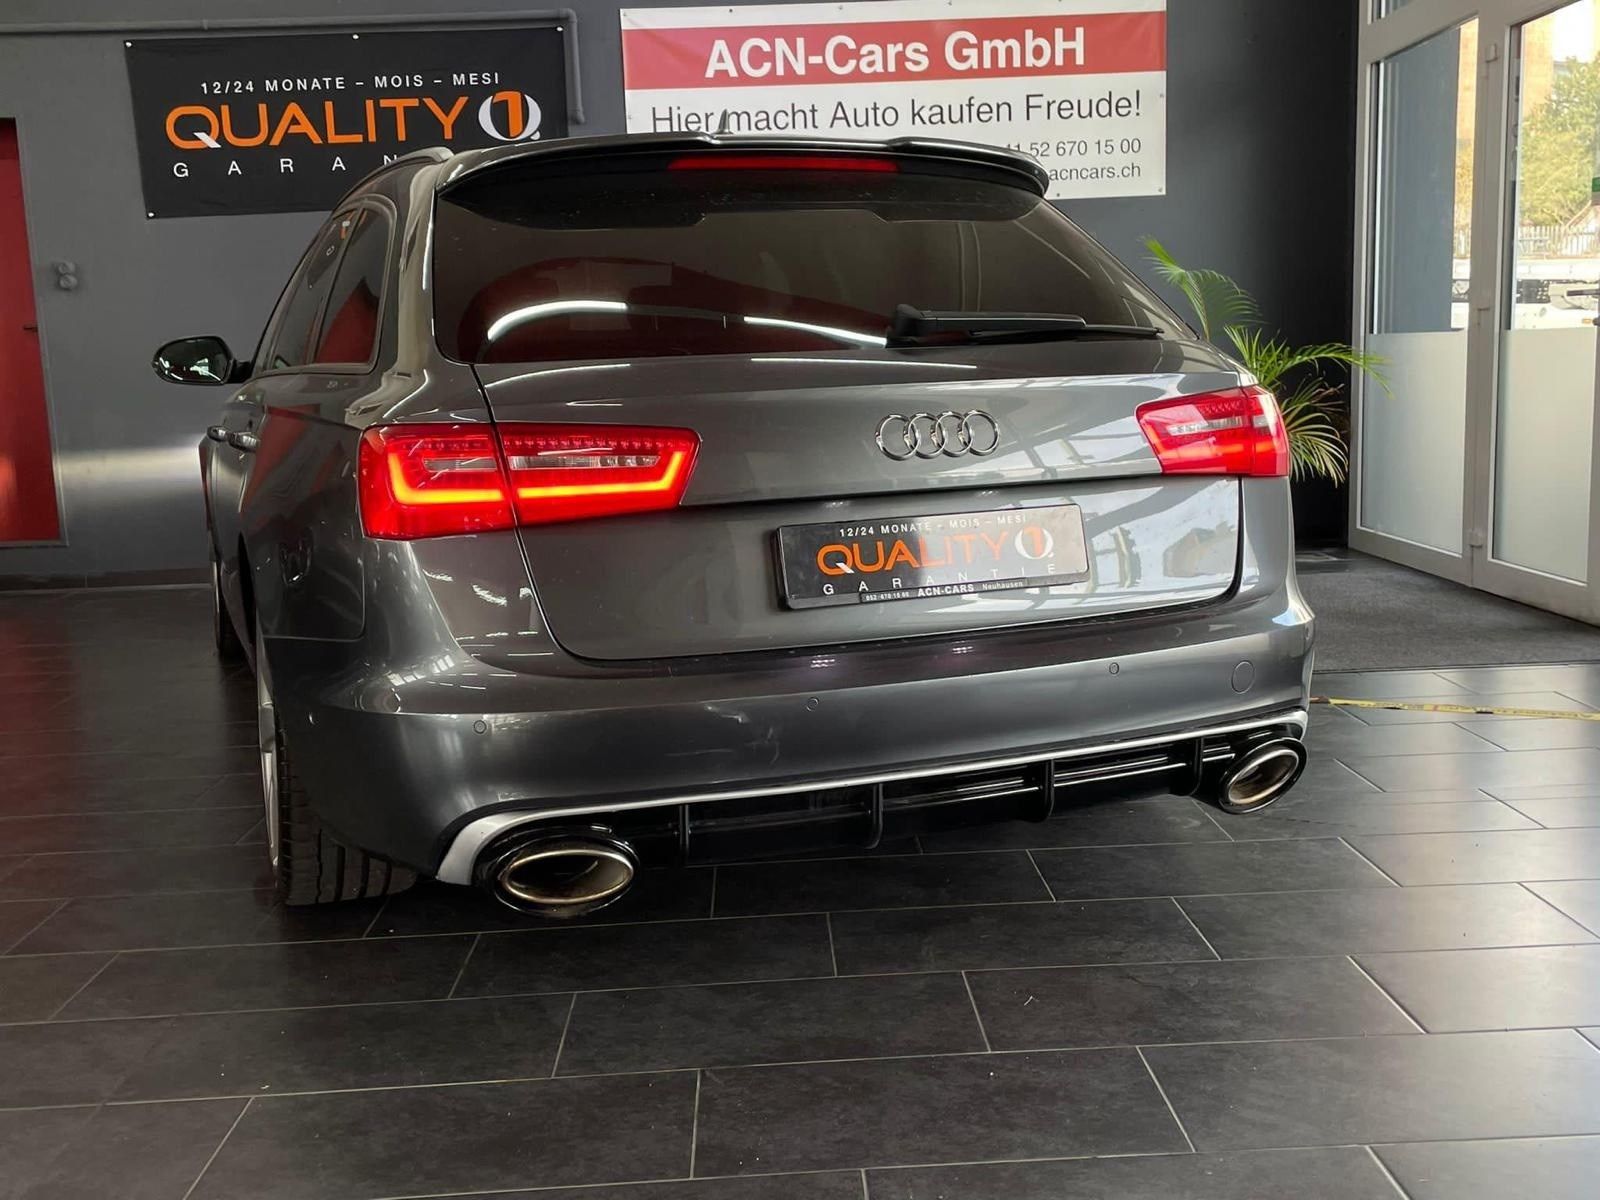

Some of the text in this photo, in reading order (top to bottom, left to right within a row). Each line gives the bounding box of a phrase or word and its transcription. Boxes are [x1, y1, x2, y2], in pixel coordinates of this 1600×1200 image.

[704, 26, 1086, 79] ACN-Cars GmbH
[201, 80, 255, 95] 12/24
[265, 77, 346, 92] MONATE
[374, 74, 424, 88] MOIS
[452, 72, 500, 86] MESI
[165, 96, 469, 150] QUALITY
[652, 89, 1142, 132] Hier macht Auto kaufen Freude!
[1030, 142, 1050, 157] 52
[1056, 140, 1088, 157] 670
[1095, 138, 1114, 155] 15
[1120, 138, 1141, 154] 00
[840, 526, 874, 537] 12/24
[881, 521, 930, 534] MONATE
[949, 518, 980, 529] MOIS
[997, 514, 1026, 524] MESI
[816, 528, 1008, 576] QUALITY
[823, 563, 1056, 595] GARANTIE
[917, 583, 975, 598] ACN-CARS
[982, 580, 1024, 591] Neuhausen
